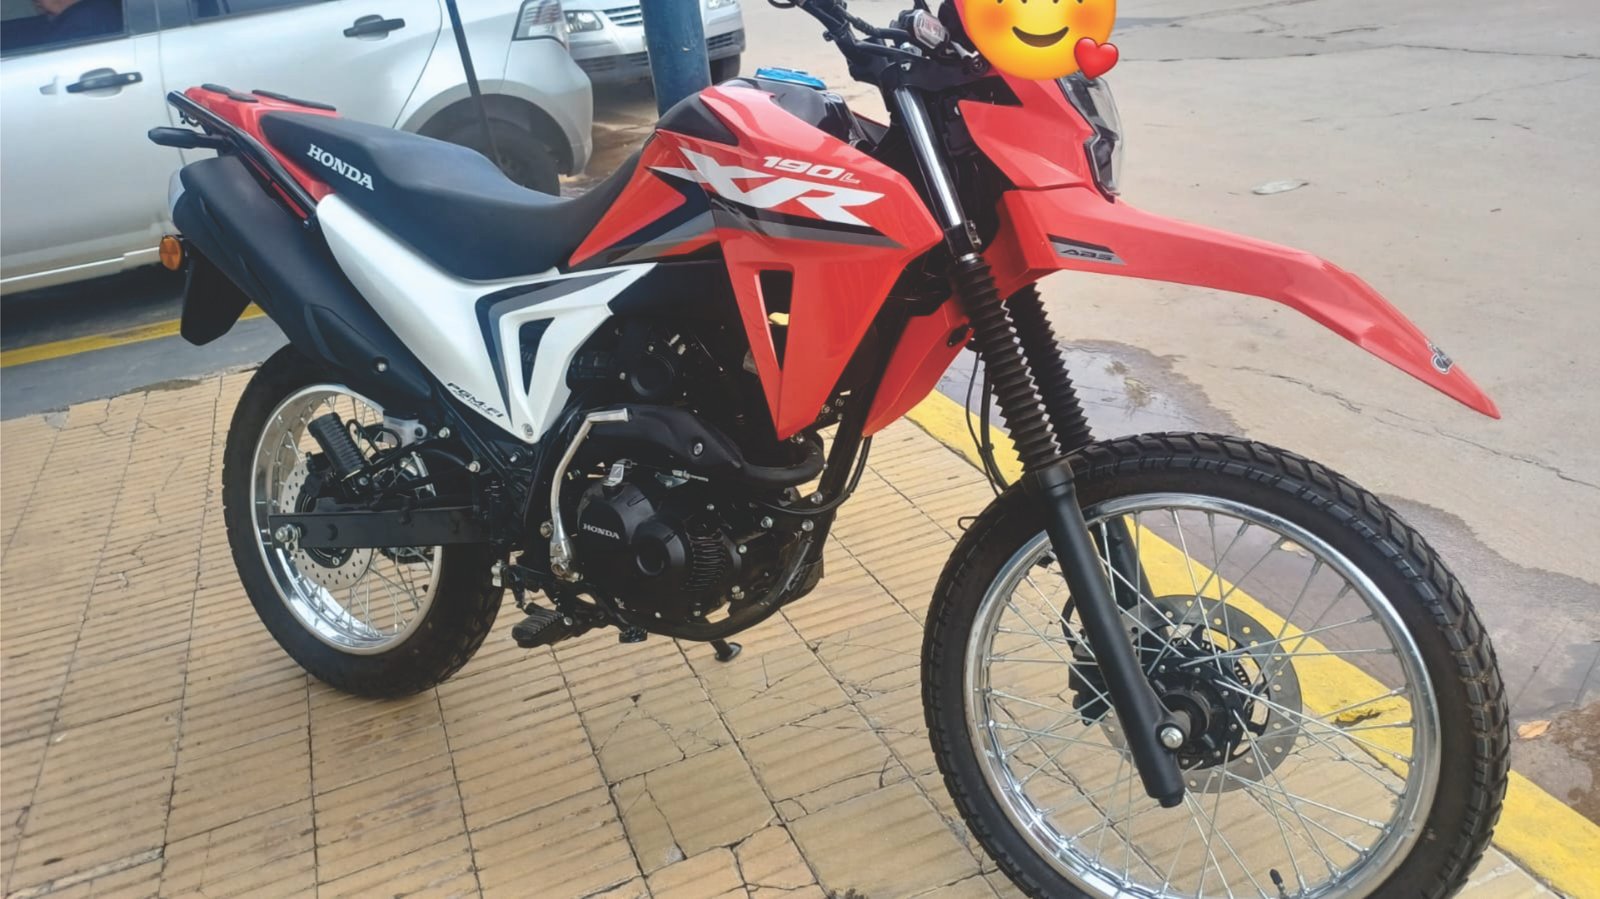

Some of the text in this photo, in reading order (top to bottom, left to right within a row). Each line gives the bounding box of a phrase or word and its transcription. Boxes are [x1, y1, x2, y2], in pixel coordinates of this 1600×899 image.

[306, 143, 375, 191] HONDA
[647, 146, 886, 228] XR
[1060, 248, 1114, 261] ABS
[583, 523, 620, 540] HONDA
